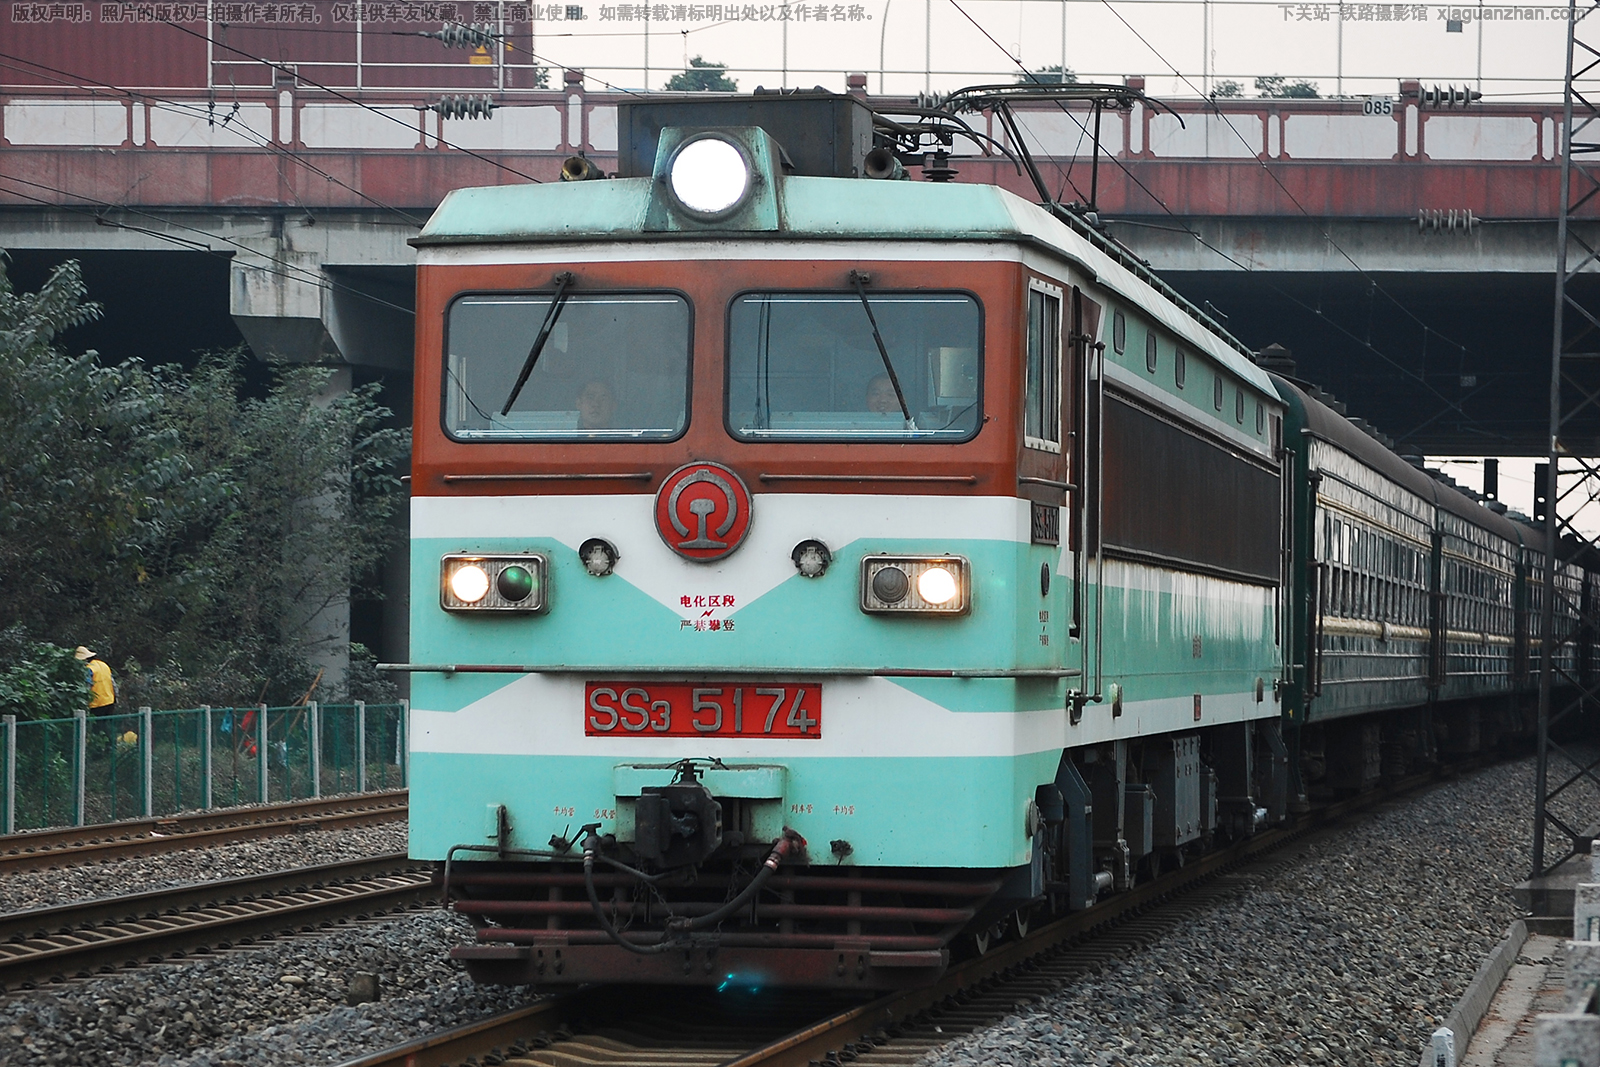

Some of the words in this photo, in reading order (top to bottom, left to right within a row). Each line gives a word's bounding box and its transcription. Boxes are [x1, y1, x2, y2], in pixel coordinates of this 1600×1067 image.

[1364, 100, 1391, 115] 085
[680, 594, 735, 608] 电化区段
[680, 619, 735, 632] 严禁攀登
[589, 687, 671, 732] SS3
[692, 687, 817, 733] 5174
